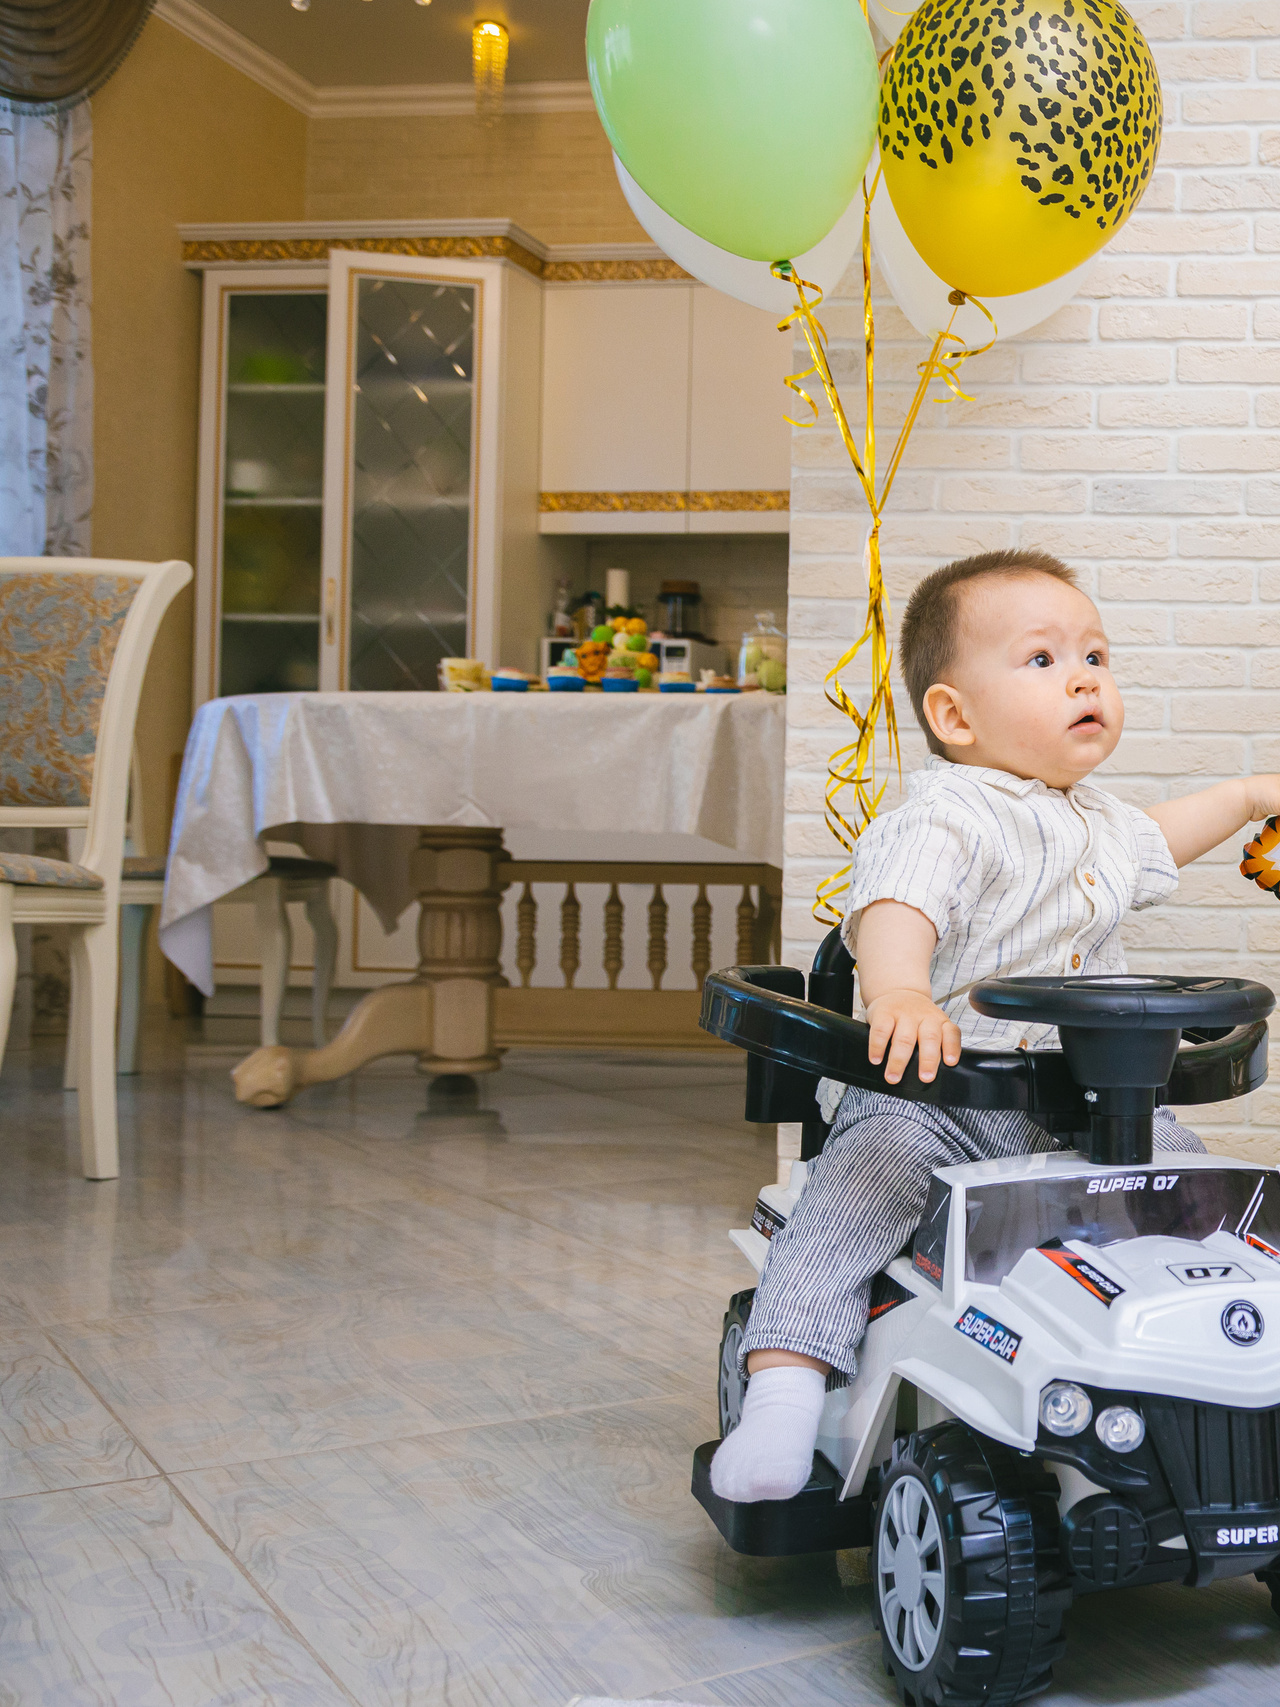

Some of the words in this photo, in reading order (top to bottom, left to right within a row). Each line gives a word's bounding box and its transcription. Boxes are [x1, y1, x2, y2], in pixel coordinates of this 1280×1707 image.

[1086, 1175, 1148, 1194] SUPER
[1152, 1174, 1180, 1191] 07
[1184, 1266, 1233, 1280] 07
[1216, 1525, 1279, 1545] SUPER
